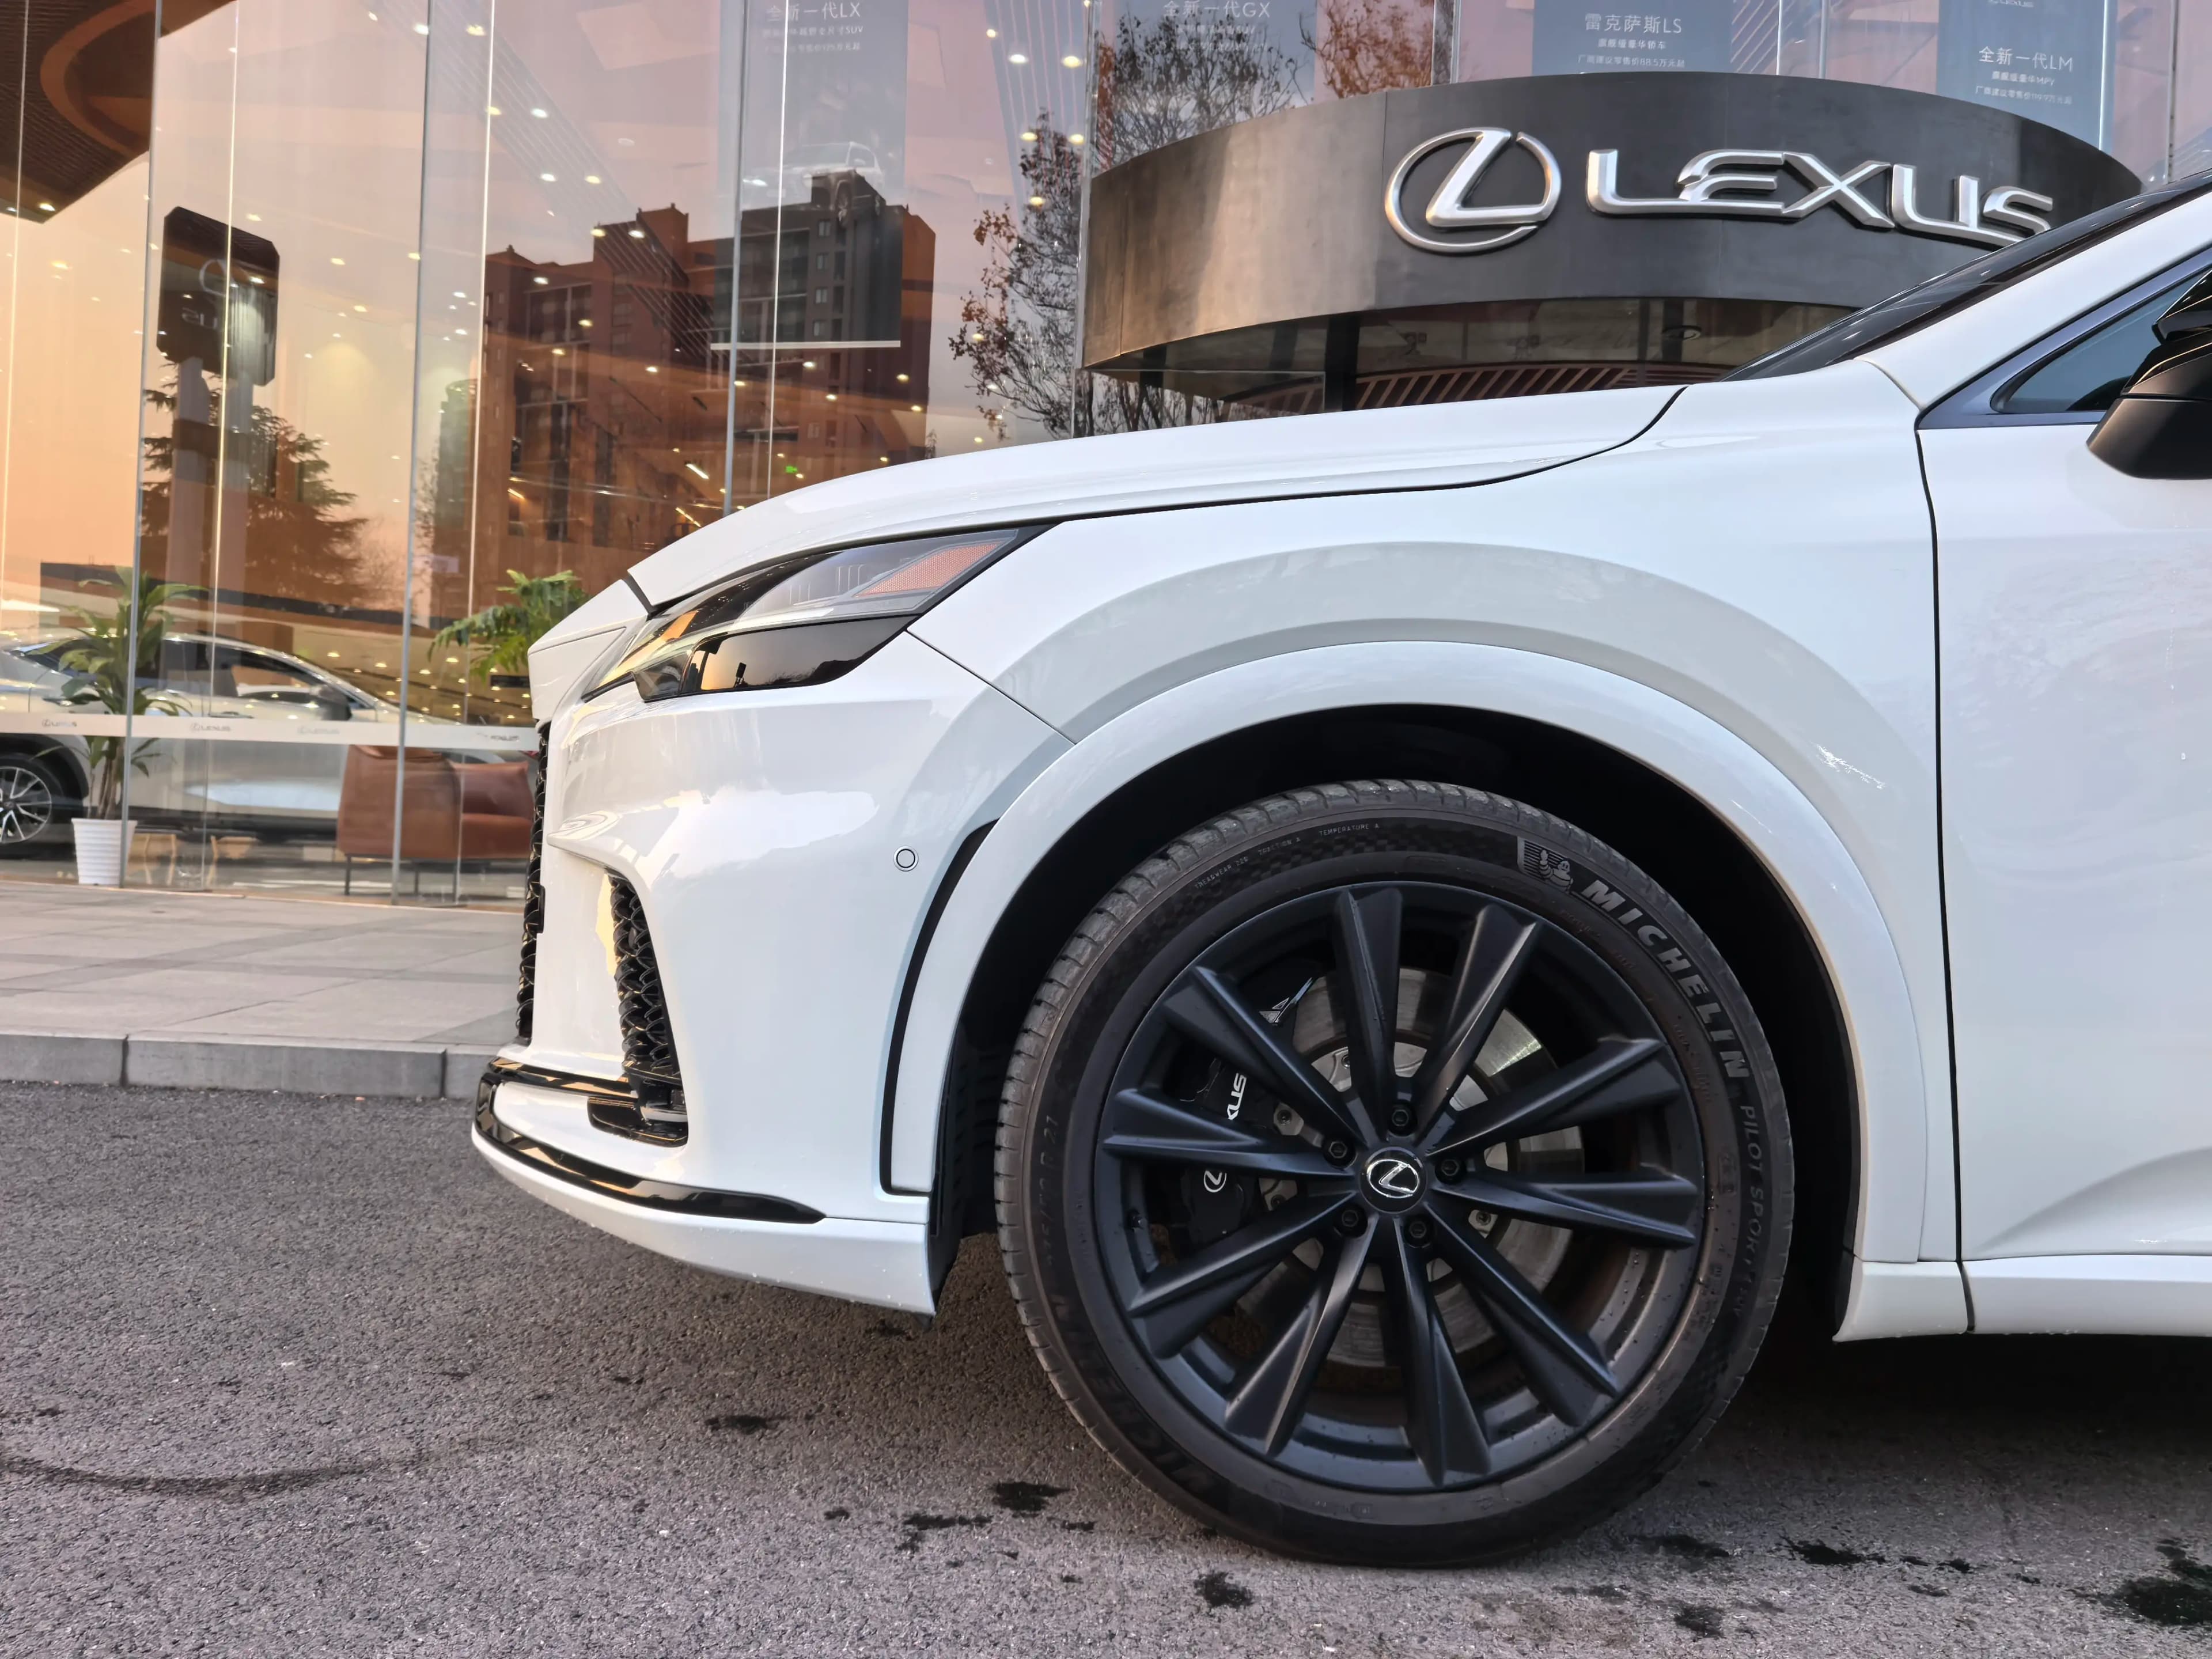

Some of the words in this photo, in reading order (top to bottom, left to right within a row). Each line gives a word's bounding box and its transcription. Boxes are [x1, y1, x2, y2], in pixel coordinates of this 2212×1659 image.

[1585, 13, 1682, 34] 雷克萨斯LS
[1979, 46, 2073, 73] 全新一代LM
[1585, 149, 2054, 248] LEXUS
[1319, 823, 1369, 836] TEMPERATURE
[1581, 880, 1750, 1078] MICHELIN
[1740, 1105, 1763, 1172] PILOT
